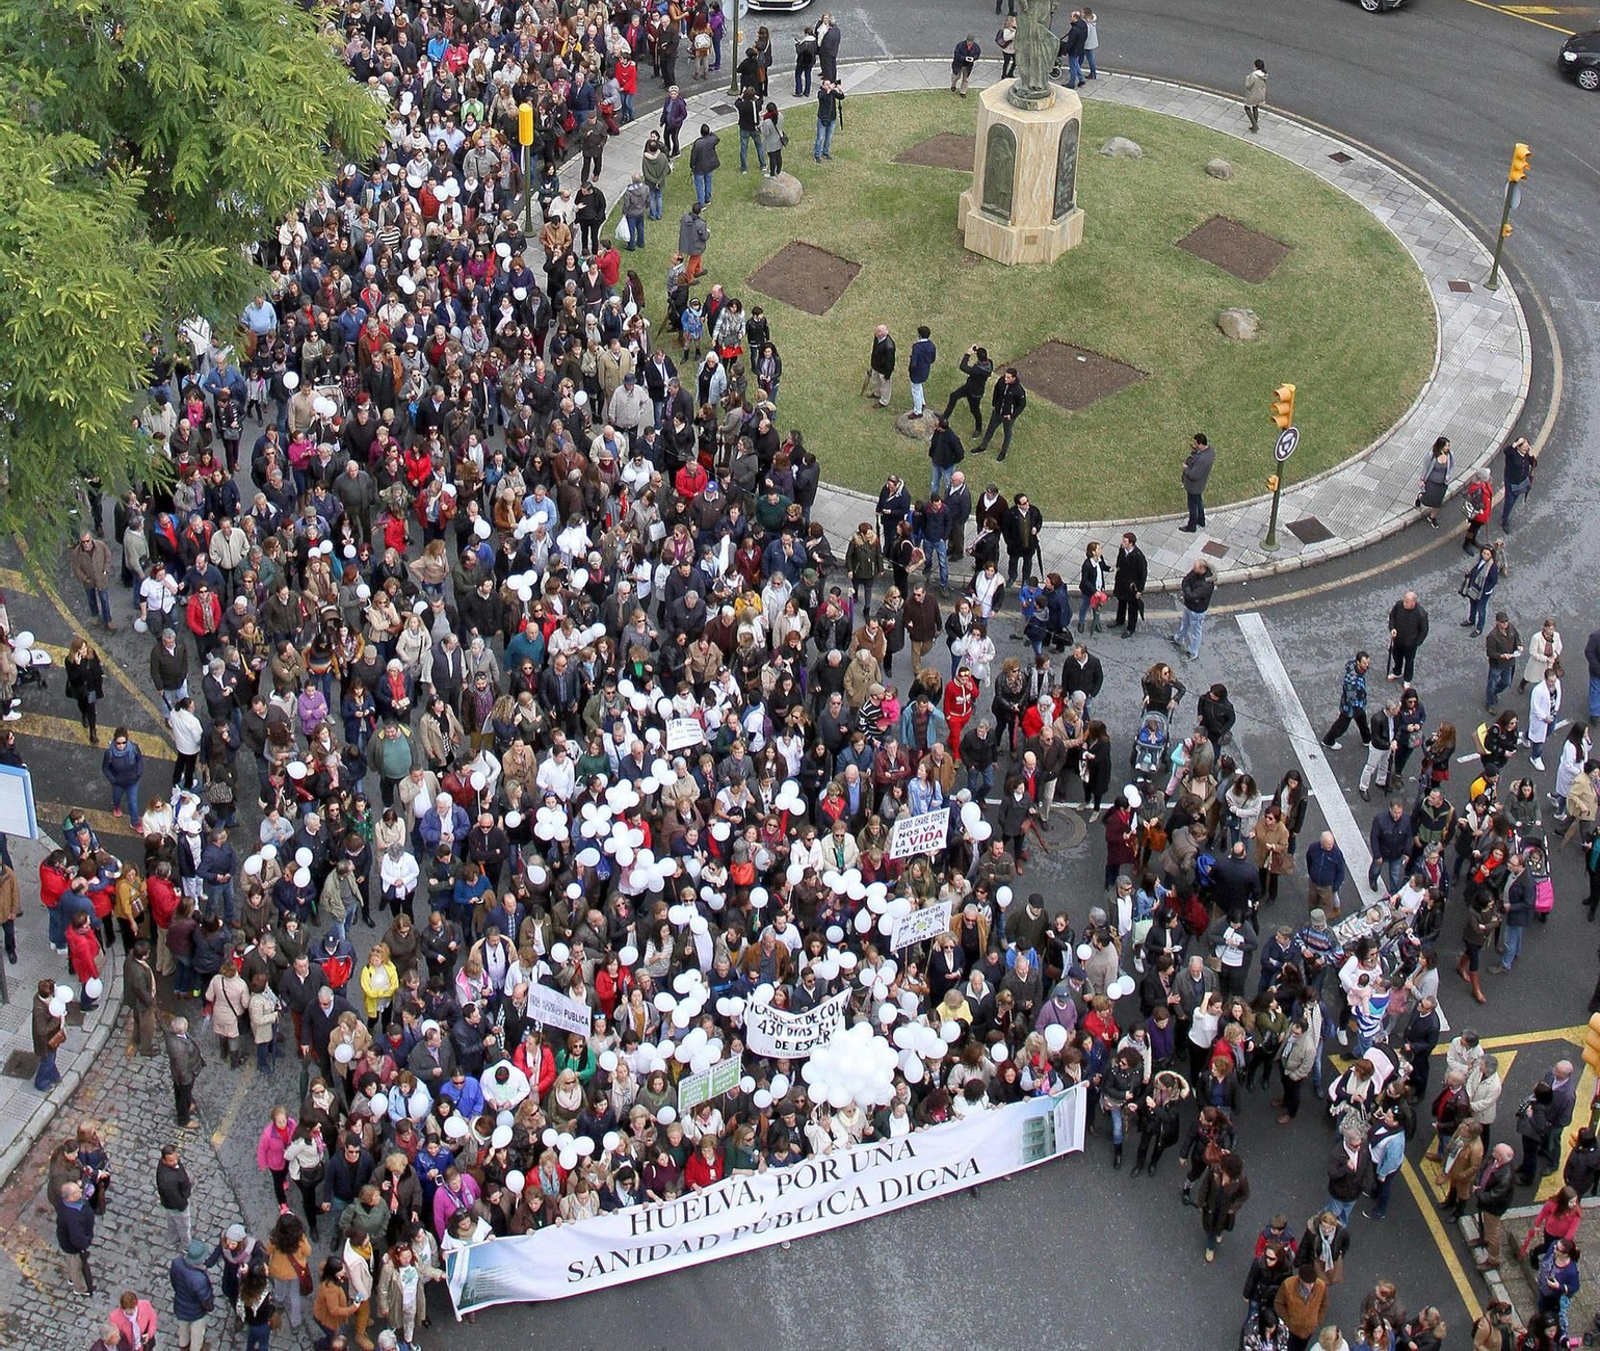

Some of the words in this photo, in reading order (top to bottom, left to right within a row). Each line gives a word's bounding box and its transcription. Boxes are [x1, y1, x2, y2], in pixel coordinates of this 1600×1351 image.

[895, 840, 906, 848] LA
[909, 829, 943, 846] VIDA
[898, 828, 919, 839] NOS
[923, 824, 936, 832] VA
[895, 848, 910, 856] EN
[913, 840, 939, 852] ELLO
[563, 1008, 589, 1026] PUBLICA
[805, 1013, 819, 1025] DE
[757, 1019, 783, 1036] 430
[775, 1039, 789, 1051] DE
[630, 1180, 765, 1236] HUELVA,
[775, 1158, 841, 1197] POR
[850, 1138, 916, 1173] UNA
[567, 1233, 720, 1283] SANIDAD
[732, 1185, 869, 1241] PÚBLICA
[879, 1157, 982, 1204] DIGNA
